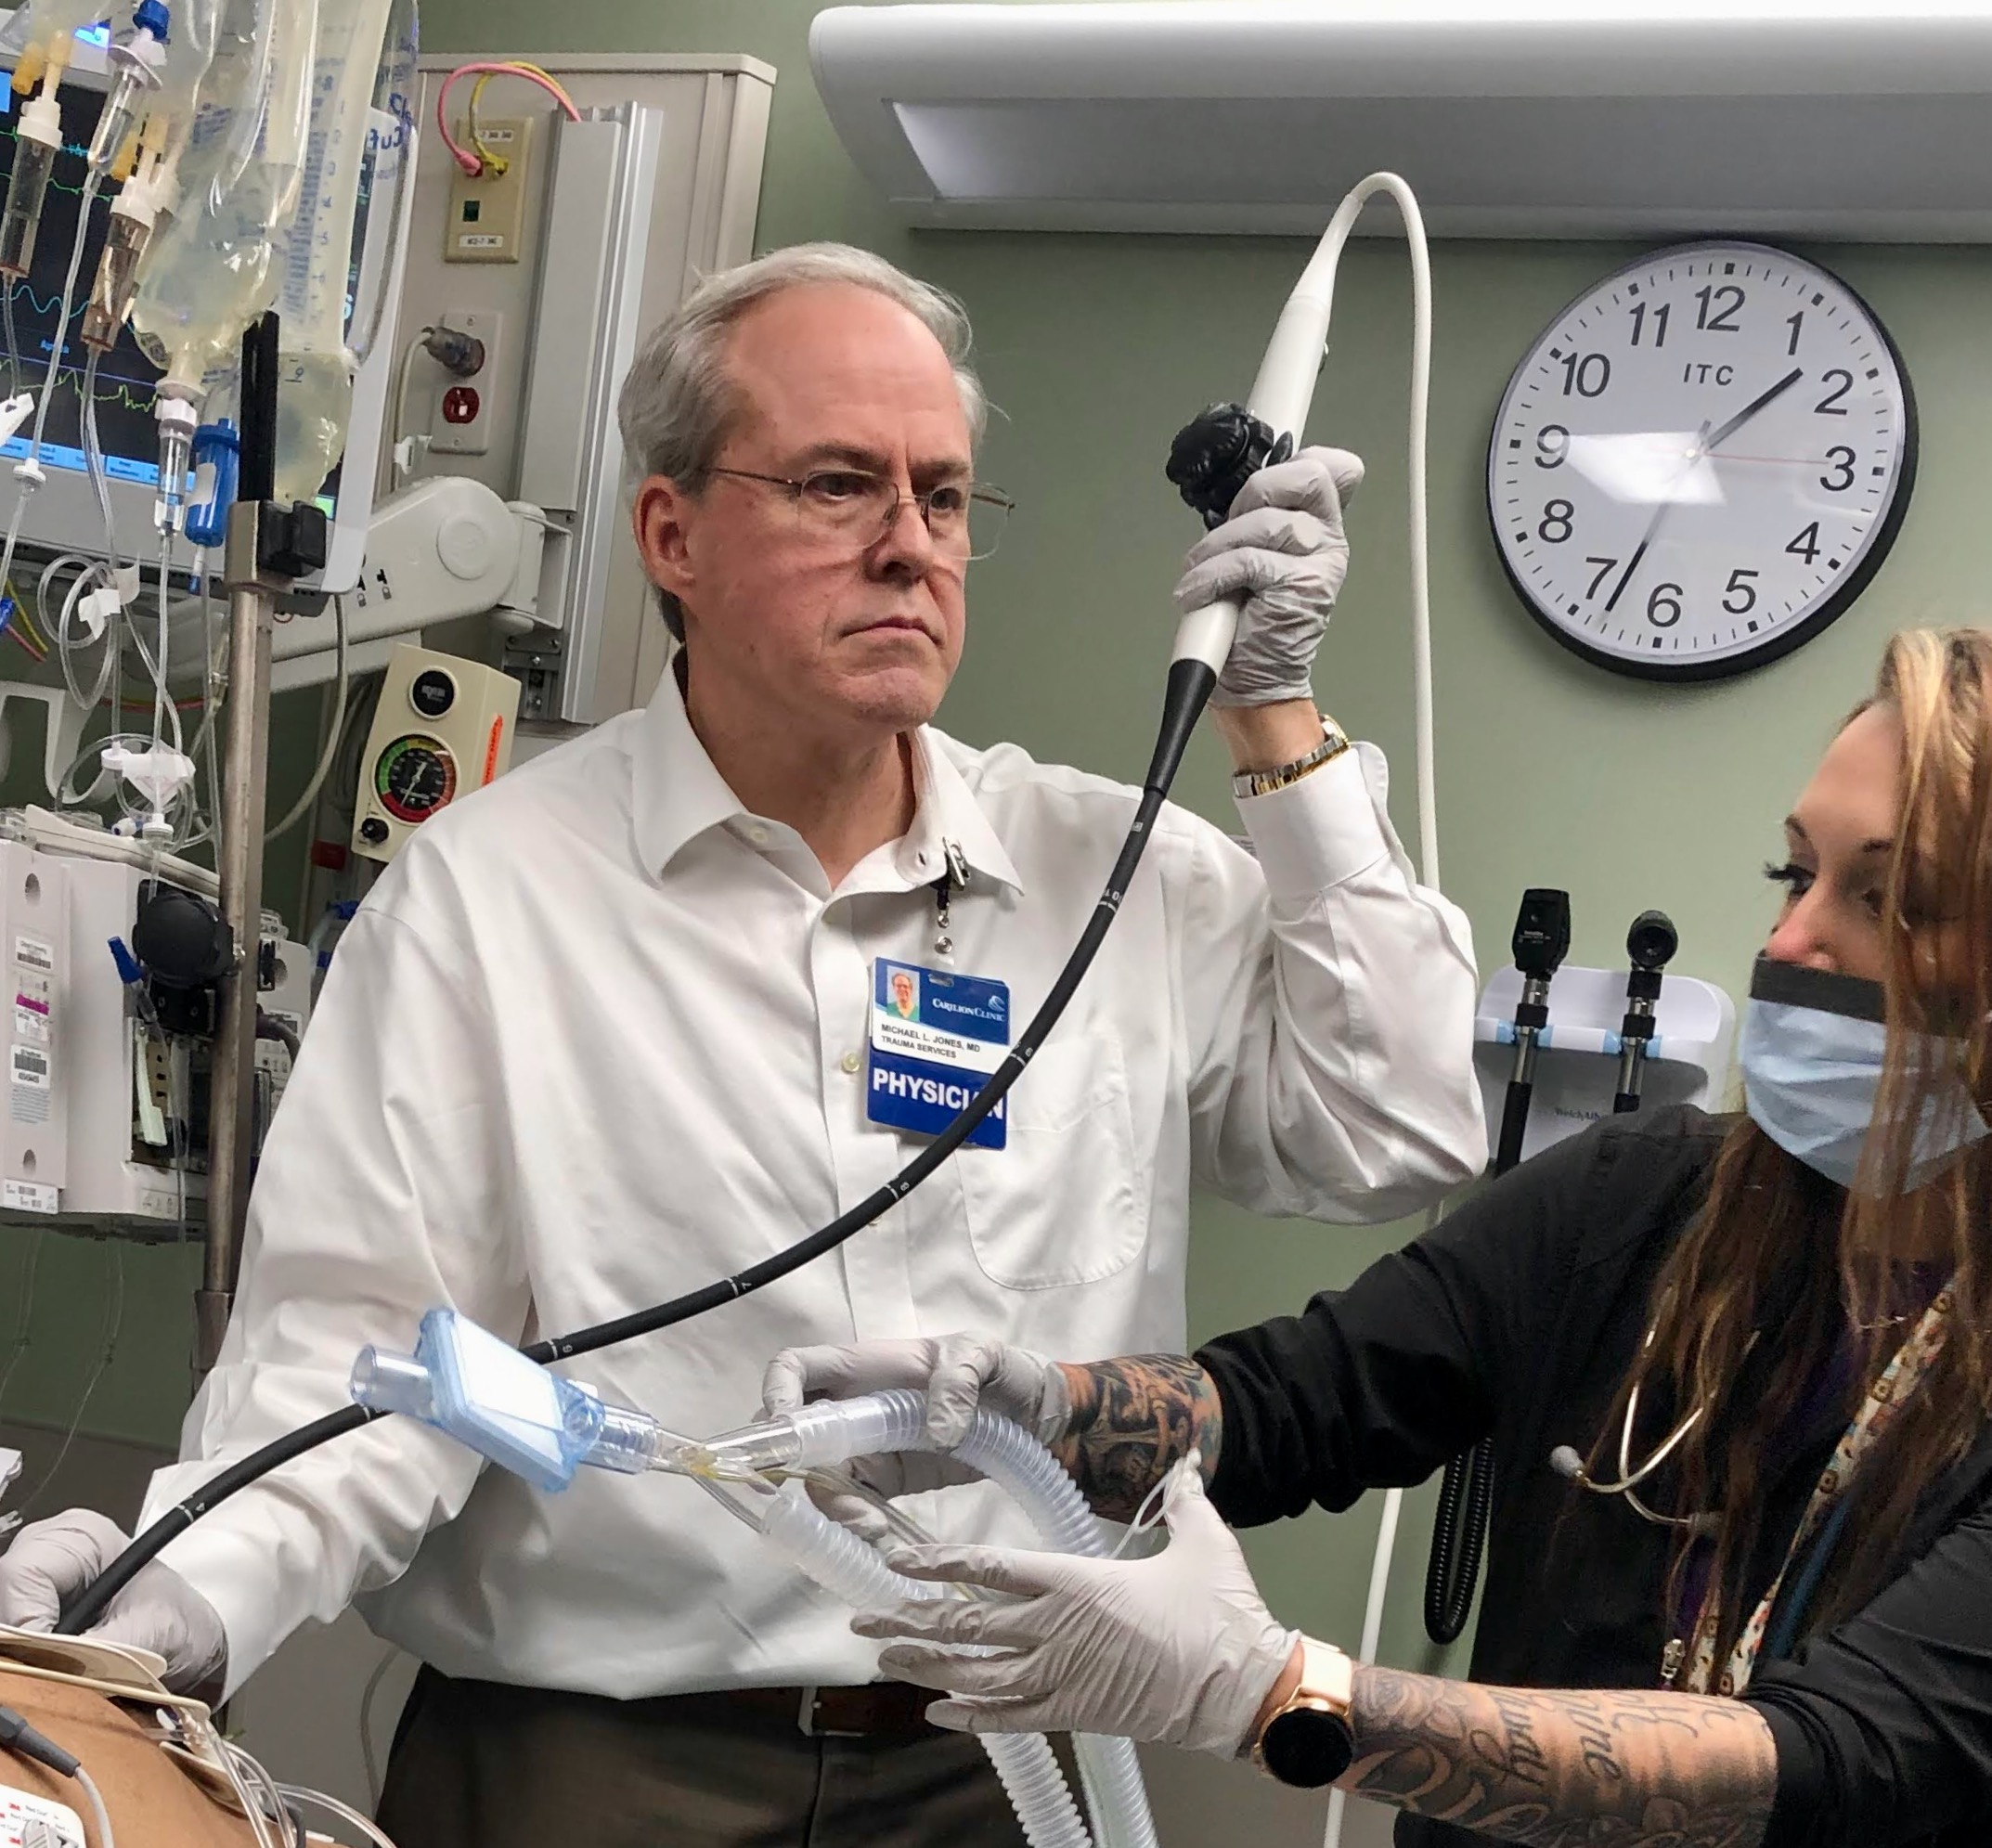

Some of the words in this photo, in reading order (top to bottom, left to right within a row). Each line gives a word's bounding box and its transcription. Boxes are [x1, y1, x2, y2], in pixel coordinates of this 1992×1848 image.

[1629, 302, 1670, 347] 11
[1695, 285, 1746, 331] 12
[1786, 311, 1804, 355] 1
[1560, 352, 1610, 397] 10
[1683, 363, 1734, 386] ITC
[1814, 369, 1854, 415] 2
[1534, 424, 1571, 469] 9
[1819, 446, 1856, 491] 3
[1538, 498, 1574, 544] 8
[1785, 522, 1820, 565] 4
[1585, 556, 1617, 601] 7
[1722, 569, 1759, 614] 5
[1647, 583, 1684, 627] 6
[881, 1024, 920, 1040] MICHAEL
[923, 1033, 930, 1042] L.
[933, 1036, 964, 1051] JONES,
[966, 1042, 980, 1053] MD
[881, 1035, 915, 1049] TRAUMA
[917, 1043, 956, 1058] SERVICES
[873, 1067, 1003, 1119] PHYSICIN
